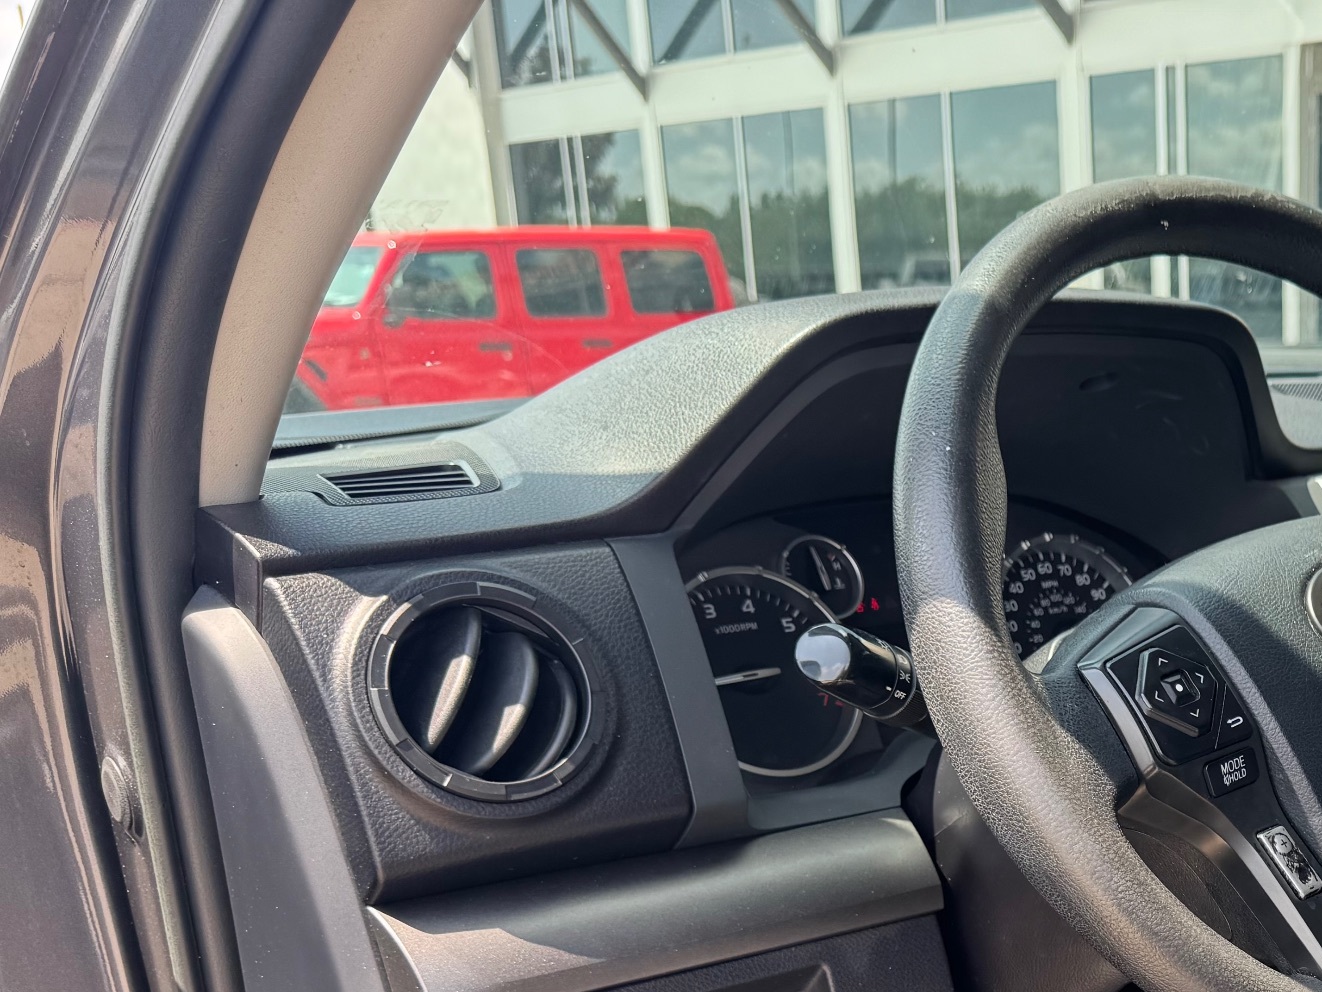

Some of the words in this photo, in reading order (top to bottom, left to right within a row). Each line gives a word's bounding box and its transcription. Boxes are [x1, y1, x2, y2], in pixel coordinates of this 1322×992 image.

[1021, 568, 1036, 581] 50
[1057, 564, 1072, 577] 70
[1075, 573, 1091, 586] 80
[1009, 581, 1024, 594] 40
[1090, 588, 1106, 601] 90
[702, 603, 717, 619] 3
[742, 599, 756, 614] 4
[781, 617, 796, 633] 5
[894, 690, 907, 700] OFF
[1220, 755, 1246, 775] MODE
